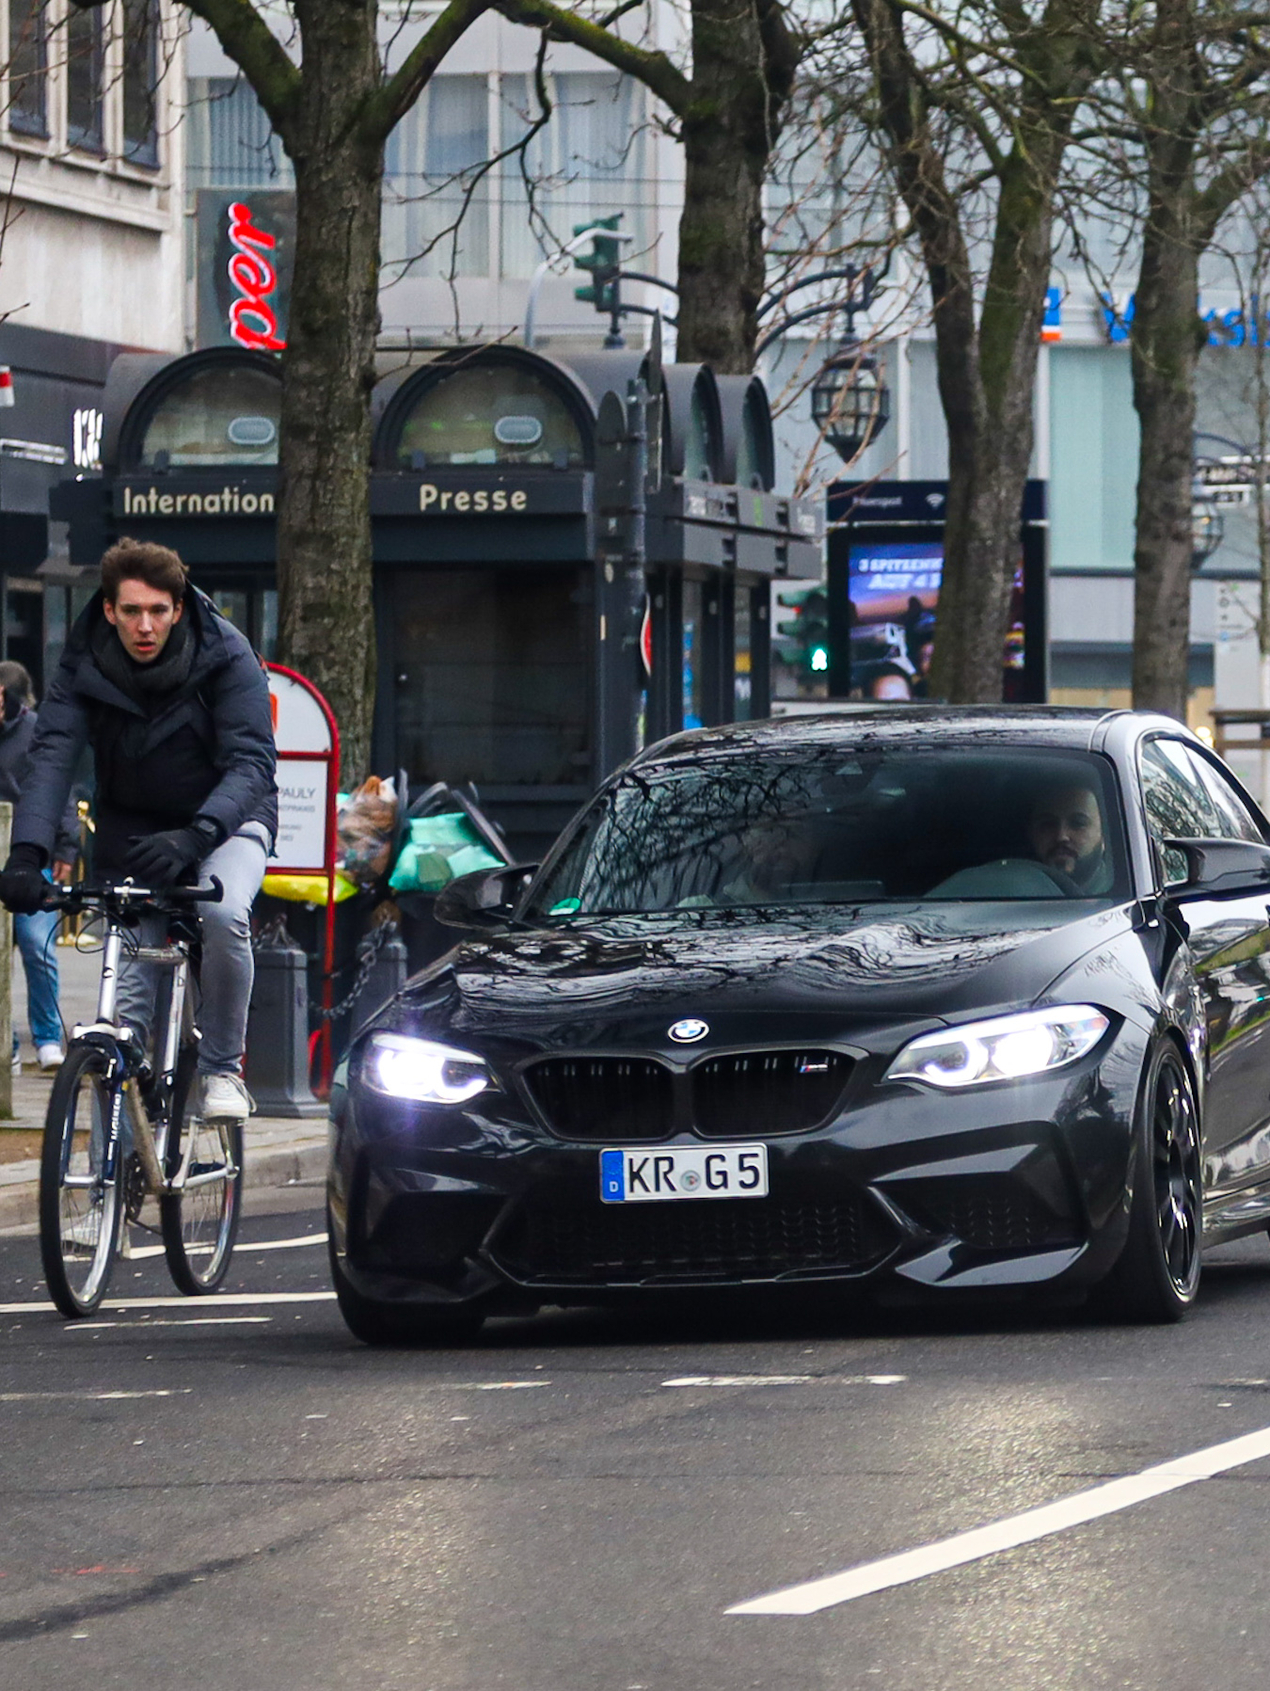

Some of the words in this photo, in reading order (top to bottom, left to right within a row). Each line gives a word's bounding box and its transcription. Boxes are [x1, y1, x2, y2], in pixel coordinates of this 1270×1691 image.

[124, 486, 275, 514] Internation
[419, 484, 527, 512] Presse
[609, 1181, 618, 1193] D
[628, 1156, 677, 1193] KR
